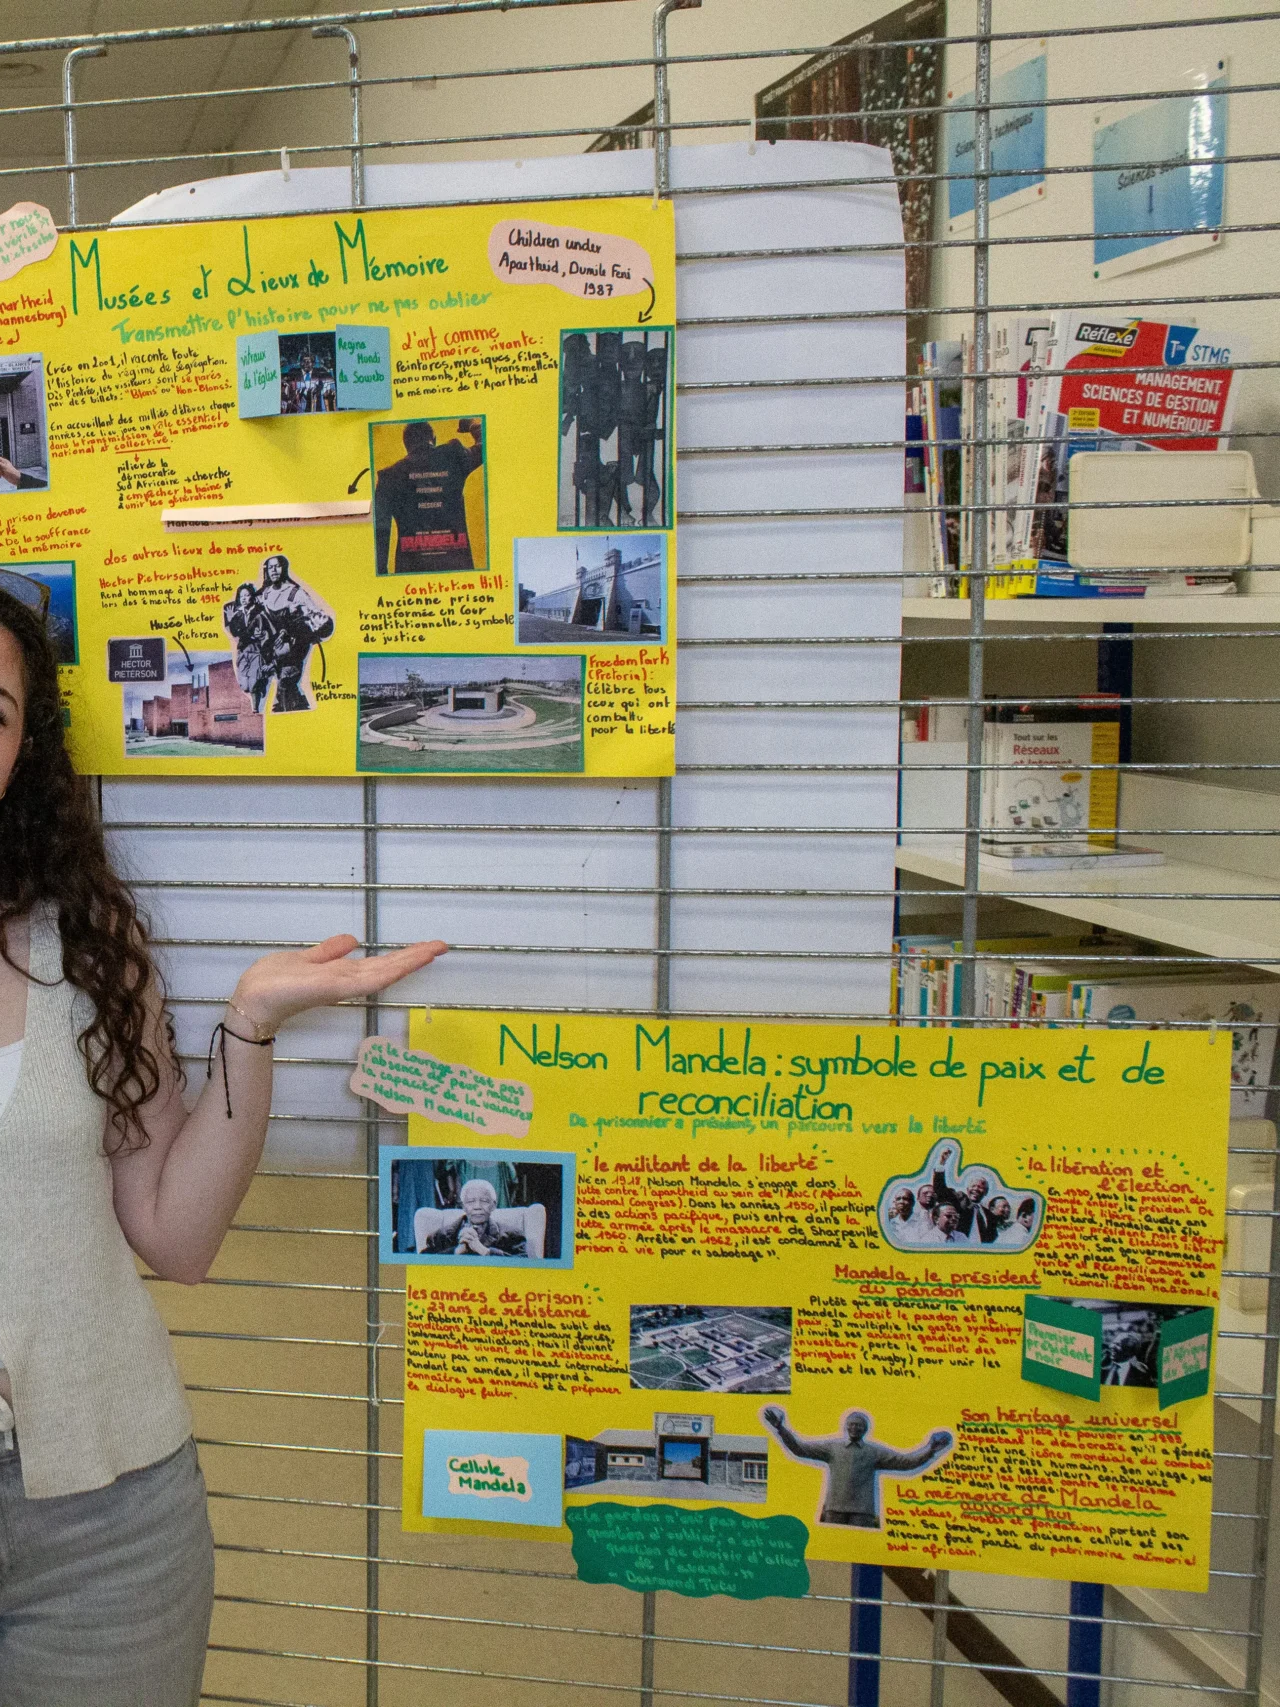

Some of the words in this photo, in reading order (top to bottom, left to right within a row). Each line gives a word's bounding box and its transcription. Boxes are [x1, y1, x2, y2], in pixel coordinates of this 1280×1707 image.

[1117, 164, 1157, 191] Sciences
[508, 228, 560, 248] Children
[566, 238, 602, 254] under
[70, 237, 172, 316] Musées
[192, 264, 212, 300] et
[307, 258, 330, 288] de
[334, 218, 449, 284] Mémoire
[569, 260, 606, 278] Dumile
[611, 264, 631, 280] Feni
[584, 282, 614, 296] 1987
[110, 312, 224, 345] Transmettre
[227, 305, 312, 332] l'histoire
[317, 301, 361, 328] pour
[368, 301, 388, 317] ne
[393, 296, 419, 317] pas
[428, 289, 492, 310] oublier
[444, 327, 500, 348] comme
[1079, 326, 1133, 345] Réflexe
[241, 346, 266, 366] vitraux
[1193, 345, 1231, 364] STMG
[1082, 384, 1142, 405] SCIENCES
[1147, 392, 1163, 406] DE
[1166, 394, 1219, 414] GESTION
[1123, 410, 1138, 424] ET
[1143, 412, 1214, 434] NUMÉRIQUE
[377, 594, 441, 610] Ancienne
[450, 594, 495, 610] prison
[114, 670, 157, 678] PIETERSON
[121, 660, 152, 668] HECTOR
[1013, 744, 1059, 756] Réseaux
[500, 1023, 607, 1070] Nelson
[635, 1024, 766, 1076] Mandela
[790, 1034, 918, 1095] symbole
[929, 1036, 968, 1079] de
[978, 1056, 1046, 1107] paix
[1058, 1045, 1096, 1083] et
[1122, 1041, 1165, 1084] de
[638, 1081, 852, 1122] reconciliation
[594, 1156, 610, 1172] le
[614, 1154, 690, 1172] militant
[698, 1156, 720, 1172] de
[728, 1155, 746, 1172] la
[759, 1153, 818, 1172] liberté
[1028, 1157, 1047, 1172] la
[1051, 1156, 1133, 1176] libération
[1142, 1162, 1164, 1178] et
[647, 1178, 684, 1187] Nelson
[690, 1176, 741, 1188] Mandela
[748, 1177, 798, 1193] s'engage
[806, 1178, 834, 1189] dans
[408, 1285, 427, 1300] les
[431, 1288, 488, 1304] années
[499, 1288, 521, 1303] de
[525, 1290, 583, 1306] prison
[859, 1282, 885, 1295] du
[896, 1285, 965, 1298] pardon
[961, 1409, 990, 1422] Son
[997, 1407, 1071, 1428] héritage
[1088, 1412, 1178, 1428] universel
[448, 1458, 505, 1477] Cellule
[459, 1477, 526, 1496] Mandela
[896, 1485, 920, 1500] La
[925, 1487, 1008, 1503] mémoire
[1021, 1490, 1050, 1506] de
[1060, 1487, 1161, 1511] Mandela
